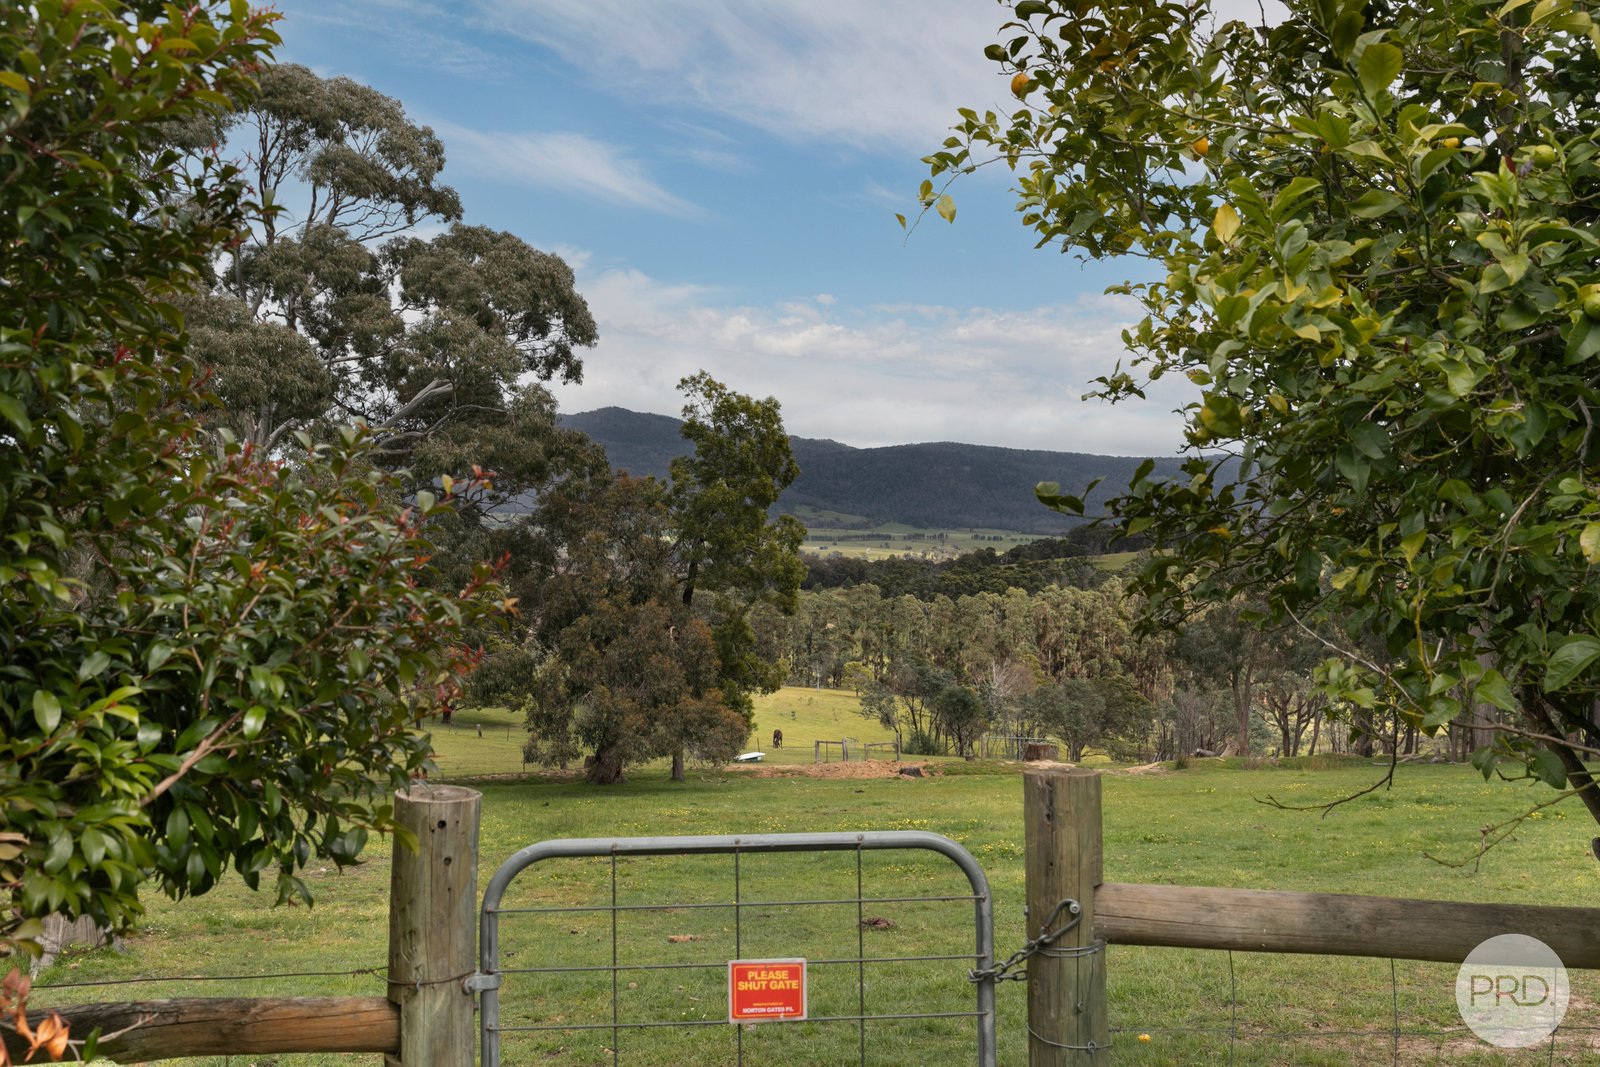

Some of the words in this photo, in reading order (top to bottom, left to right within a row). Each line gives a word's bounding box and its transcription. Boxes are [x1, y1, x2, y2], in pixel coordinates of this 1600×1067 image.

[748, 970, 789, 980] PLEASE
[738, 981, 768, 990] SHUT
[769, 980, 799, 989] GATE
